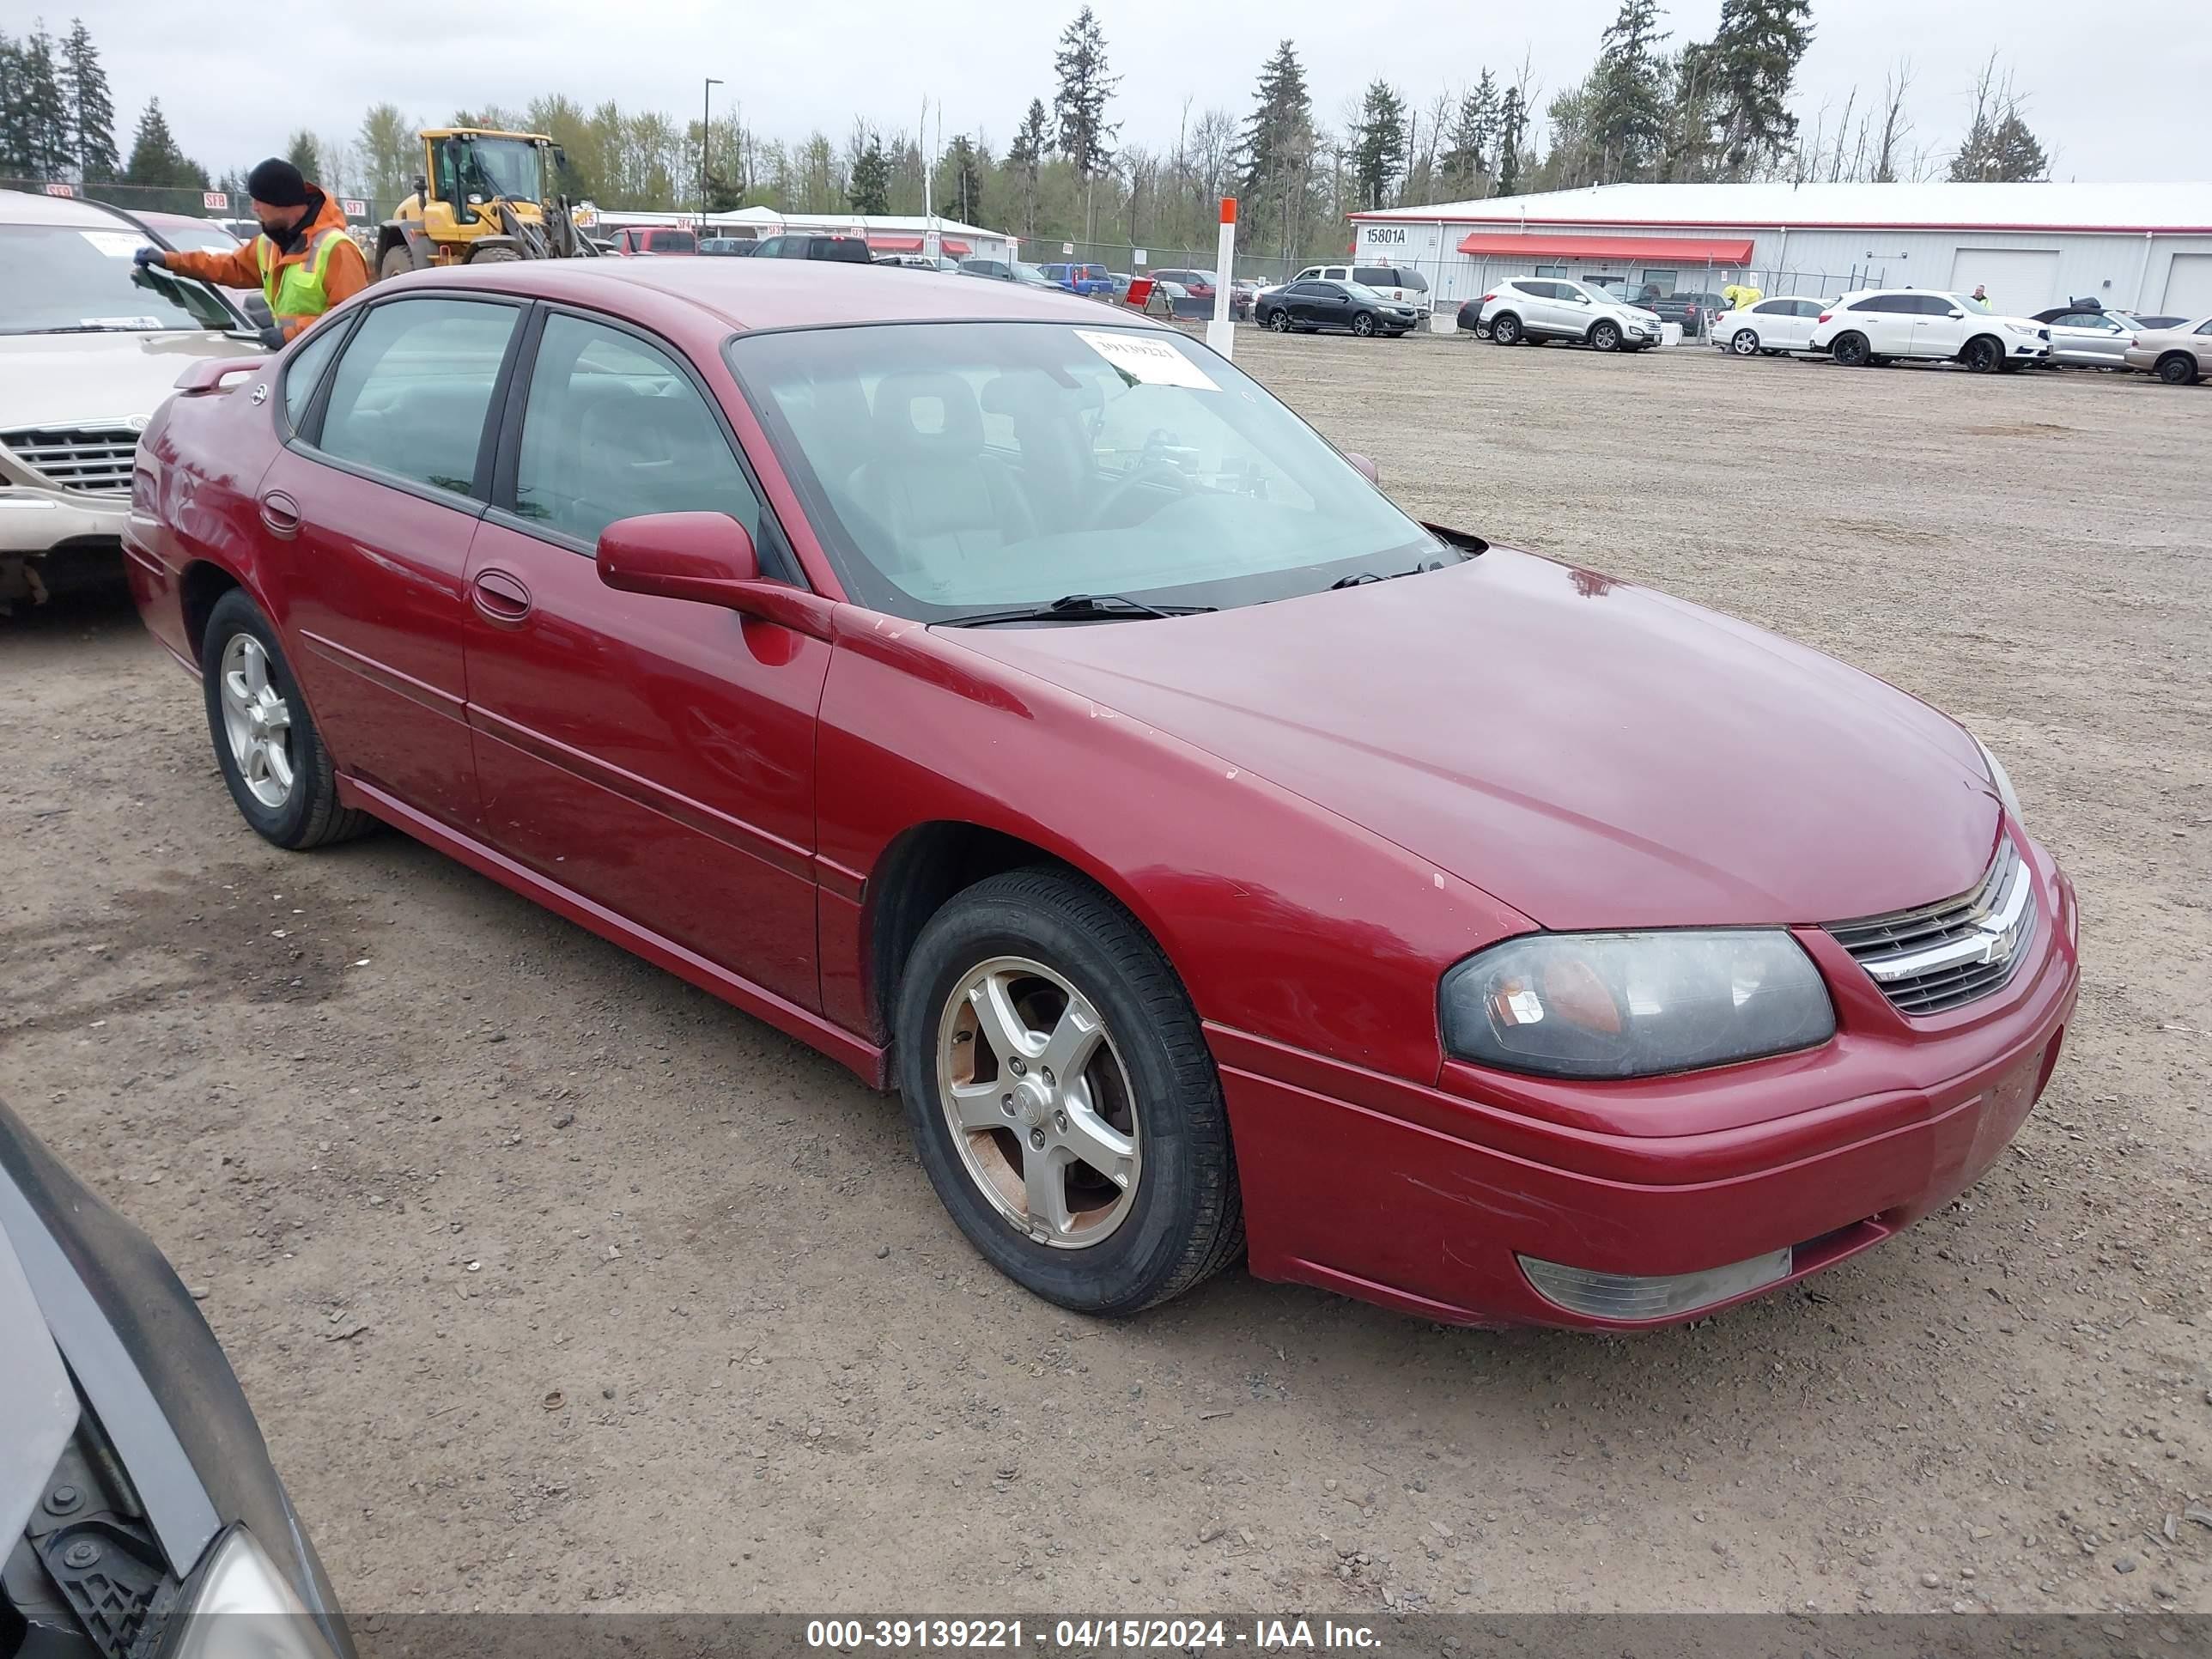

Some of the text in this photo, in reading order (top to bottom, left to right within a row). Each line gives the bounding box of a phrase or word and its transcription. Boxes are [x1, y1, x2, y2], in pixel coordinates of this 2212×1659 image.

[206, 194, 225, 206] SF8
[346, 202, 362, 213] SF7
[678, 219, 690, 229] SF4
[769, 225, 781, 234] SF3
[1366, 228, 1405, 243] 15801A
